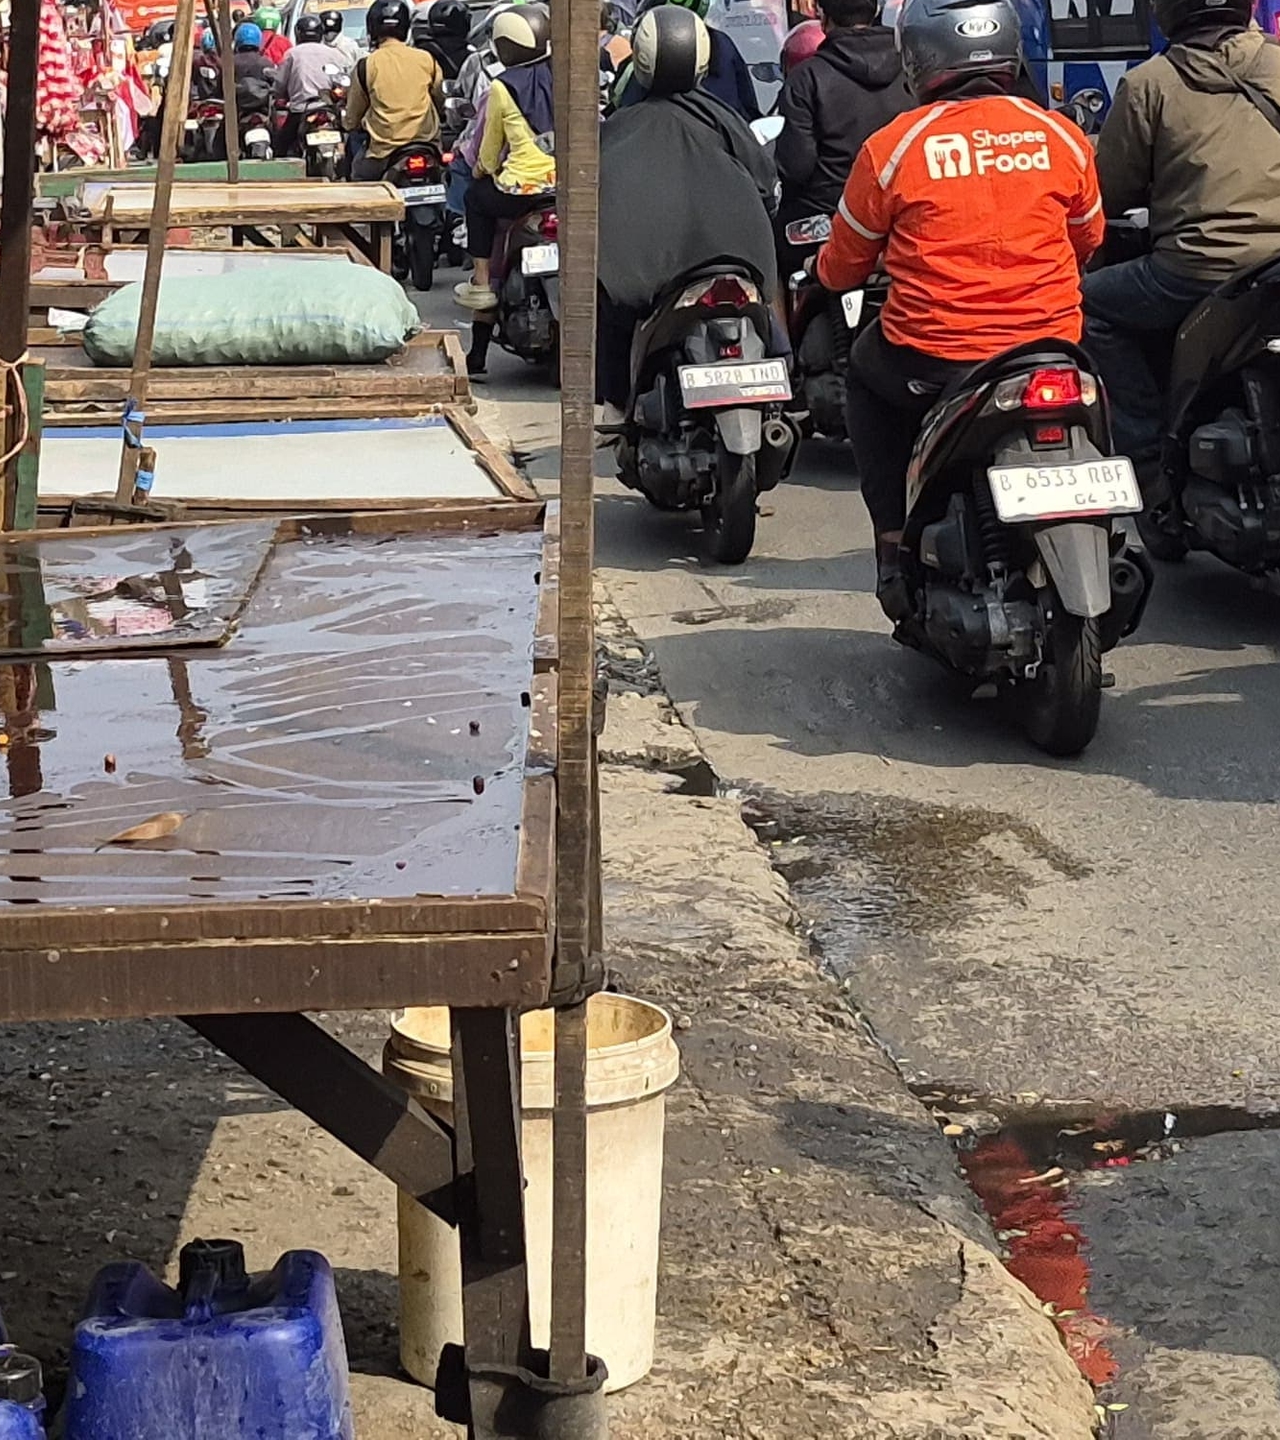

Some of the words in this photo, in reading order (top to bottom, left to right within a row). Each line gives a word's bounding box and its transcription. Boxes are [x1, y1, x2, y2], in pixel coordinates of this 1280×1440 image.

[972, 129, 1047, 149] Shopee
[975, 144, 1051, 176] Food
[1026, 469, 1078, 489] 6533
